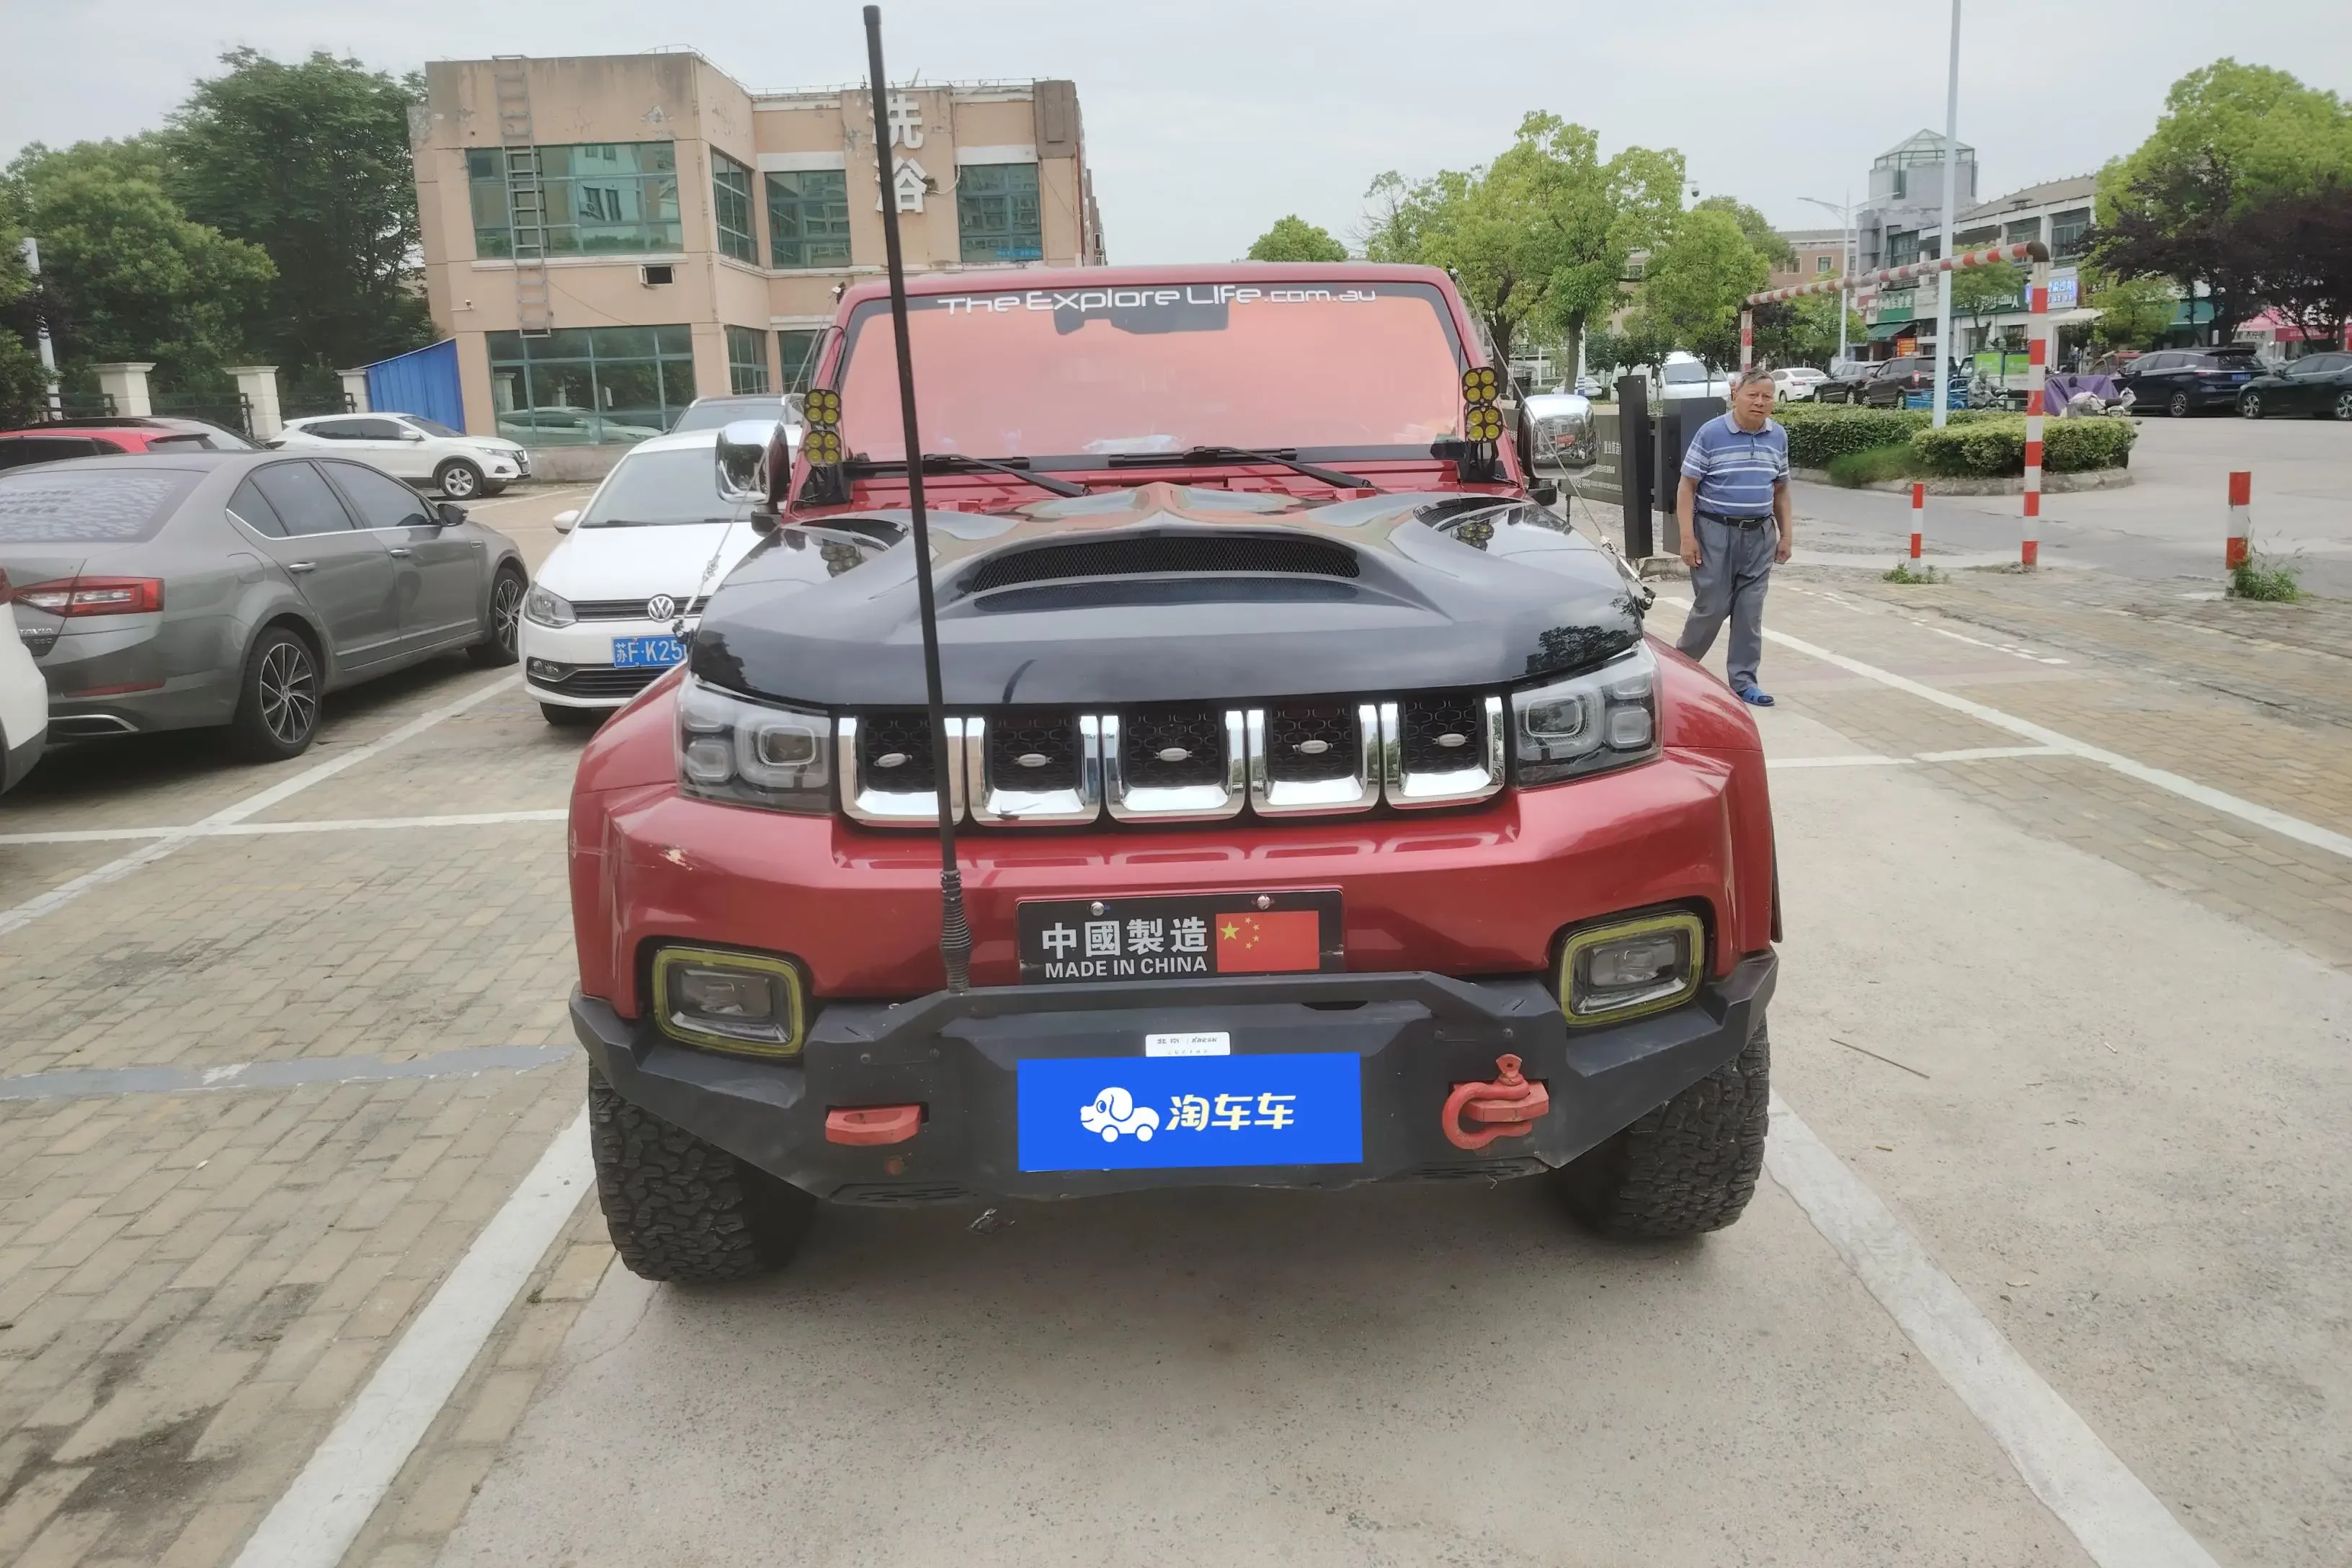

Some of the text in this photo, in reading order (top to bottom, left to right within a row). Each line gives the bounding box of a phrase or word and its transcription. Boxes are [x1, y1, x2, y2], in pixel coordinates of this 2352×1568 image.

[868, 93, 927, 214] 洗浴
[937, 295, 1020, 316] The
[1026, 288, 1180, 313] Explore
[1042, 916, 1208, 959] 中國製造
[1045, 956, 1208, 979] MADE IN CHINA
